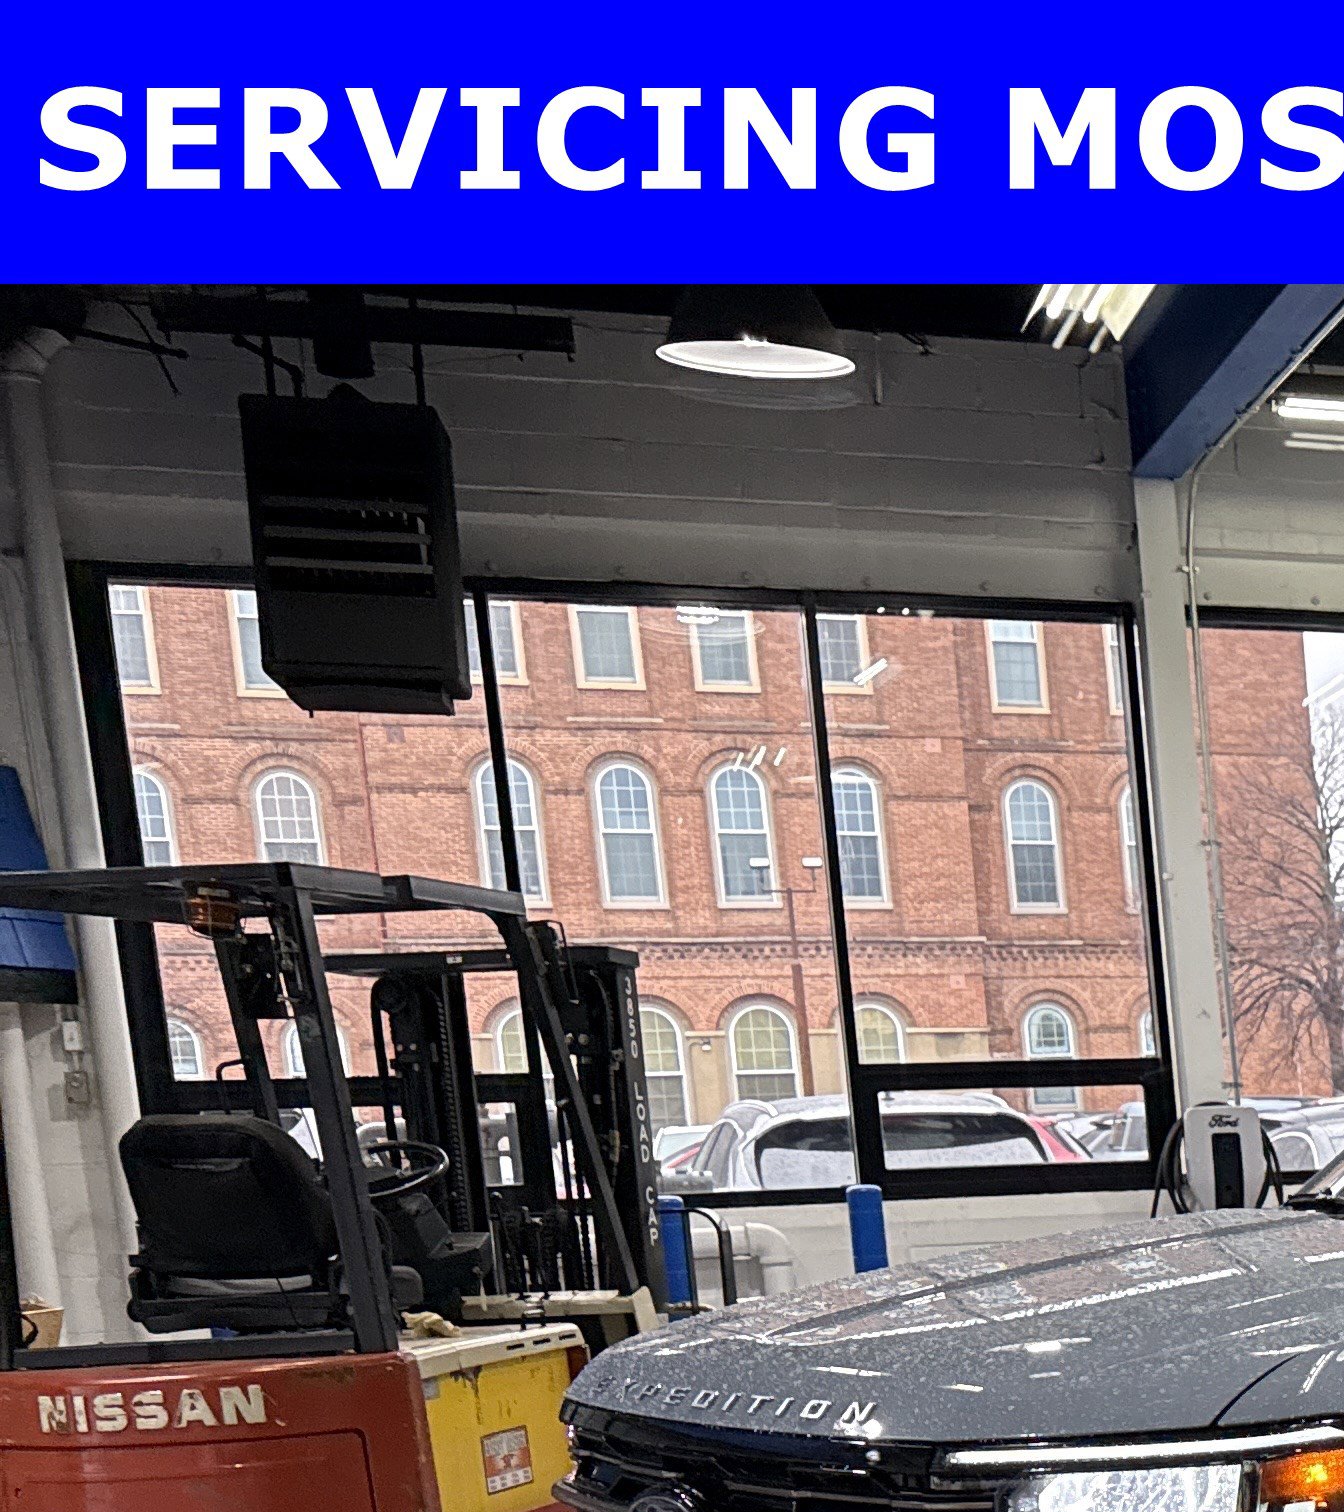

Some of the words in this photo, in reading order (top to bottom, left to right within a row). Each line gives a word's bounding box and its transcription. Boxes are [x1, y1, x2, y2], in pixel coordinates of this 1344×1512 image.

[624, 976, 638, 1059] 3850
[633, 1081, 650, 1164] LOAD
[645, 1185, 659, 1247] CAP
[1208, 1114, 1240, 1128] Ford
[37, 1384, 267, 1433] NISSAN
[596, 1375, 876, 1424] EXPEDITION
